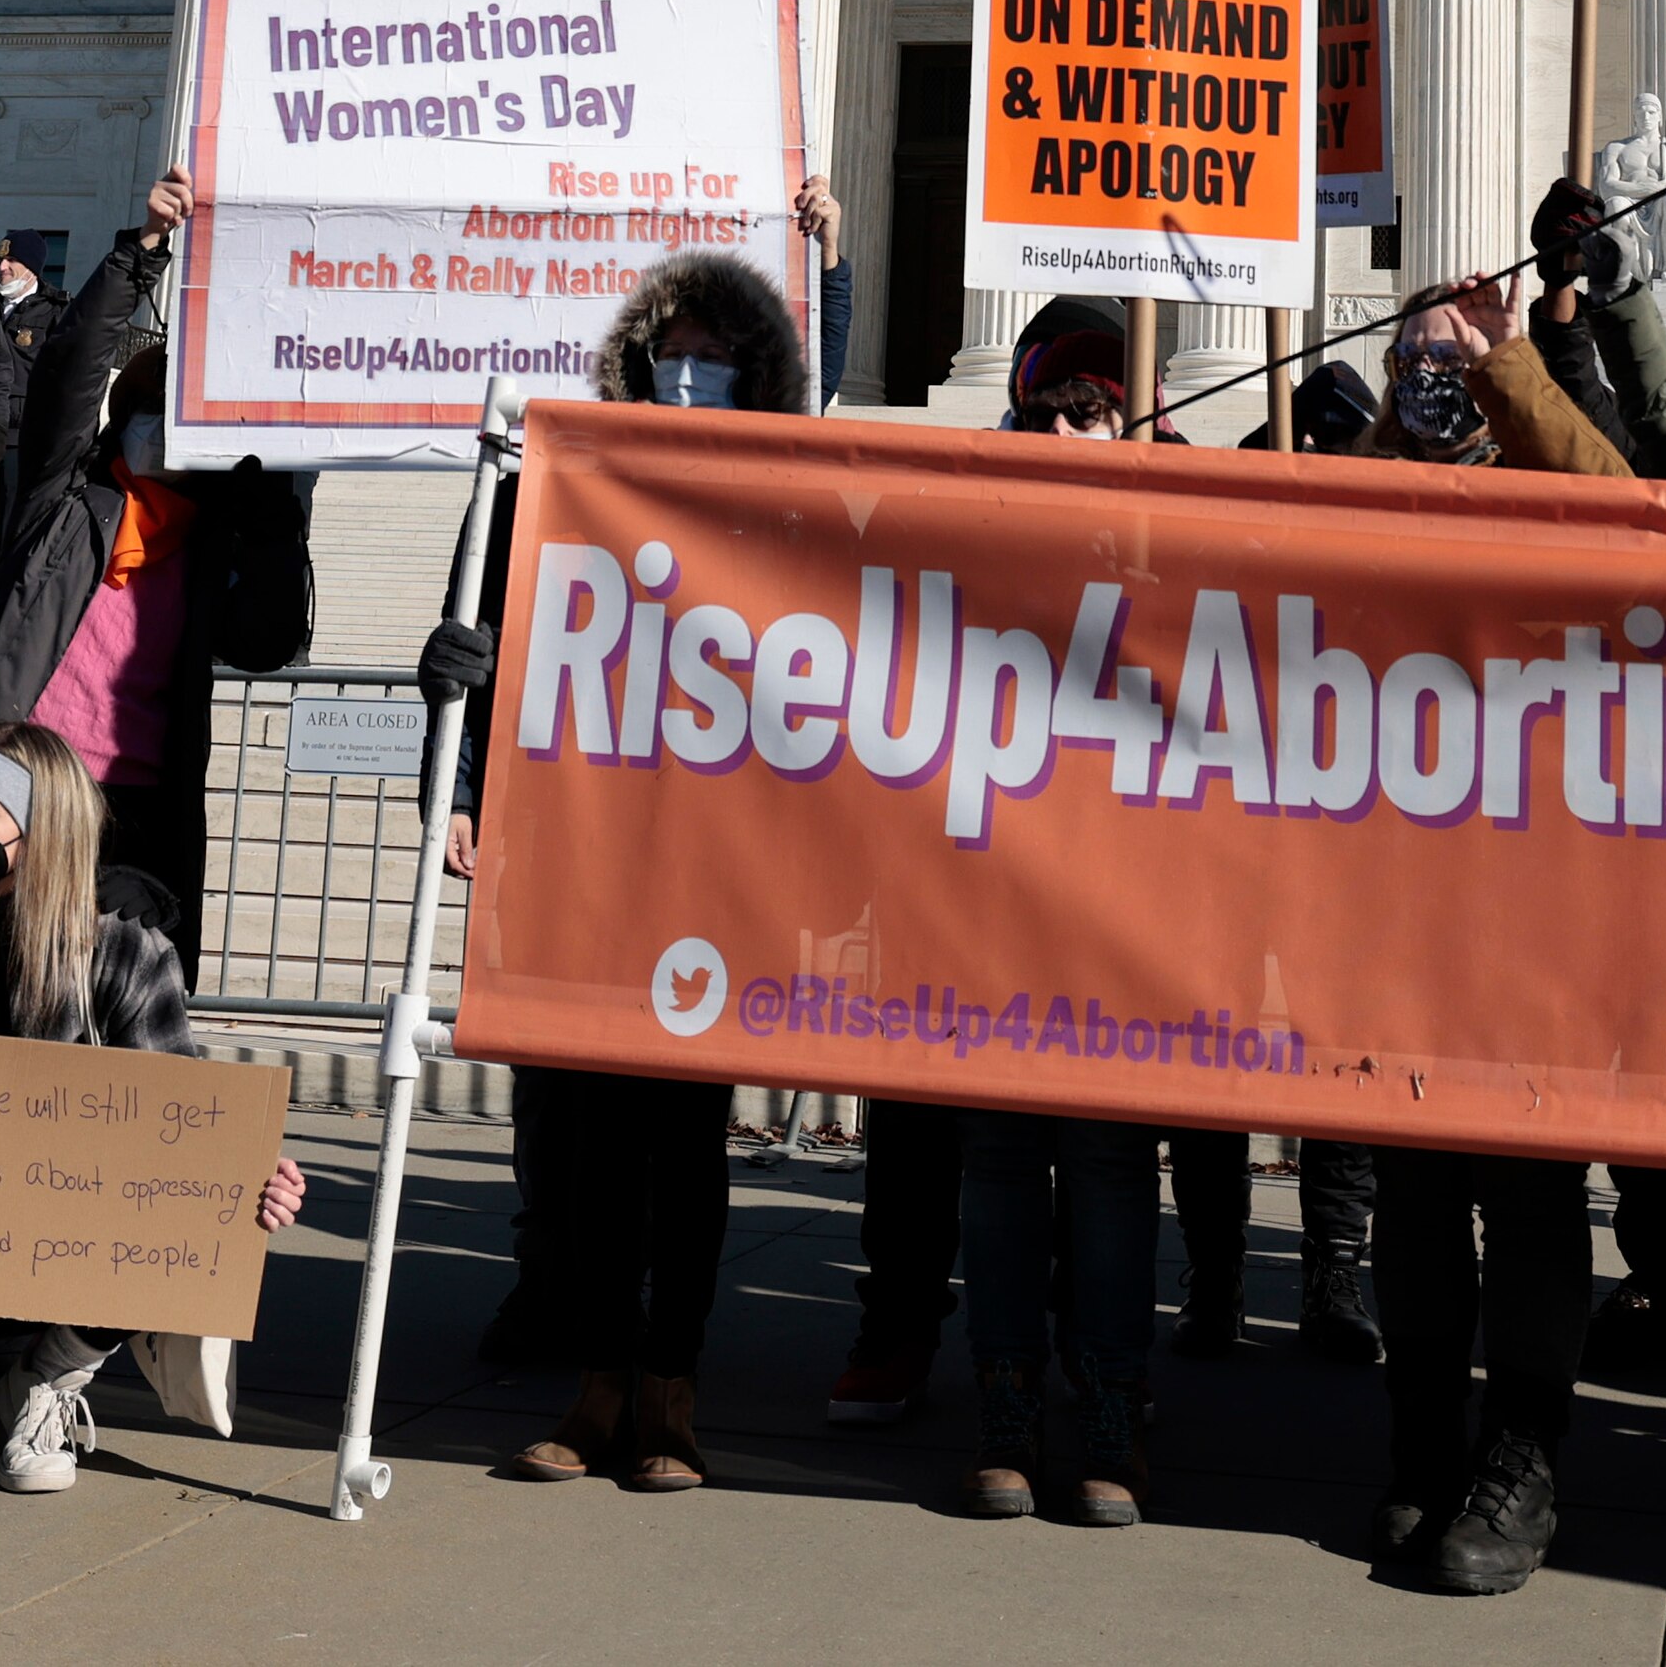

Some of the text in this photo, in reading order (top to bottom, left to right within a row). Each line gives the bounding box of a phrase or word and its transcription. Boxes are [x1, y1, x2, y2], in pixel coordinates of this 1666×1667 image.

[268, 0, 617, 71] International
[274, 75, 634, 144] Women's Day
[1002, 67, 1040, 119] &
[1056, 65, 1287, 136] WITHOUT
[548, 162, 737, 205] Rise up For
[1031, 138, 1255, 207] APOLOGY
[462, 205, 748, 251] Abortion Rights!
[288, 250, 397, 288] March
[410, 253, 436, 290] &
[447, 255, 533, 298] Rally
[1022, 246, 1256, 284] RiseUp4AbortionRights.org
[306, 711, 418, 730] AREA CLOSED
[739, 974, 1305, 1076] @RiseUp4Abortion
[26, 1086, 68, 1123] will
[163, 1095, 226, 1144] get
[26, 1160, 104, 1196] about
[122, 1176, 244, 1224] oppressing
[33, 1237, 97, 1277] poor
[111, 1239, 221, 1277] people!
